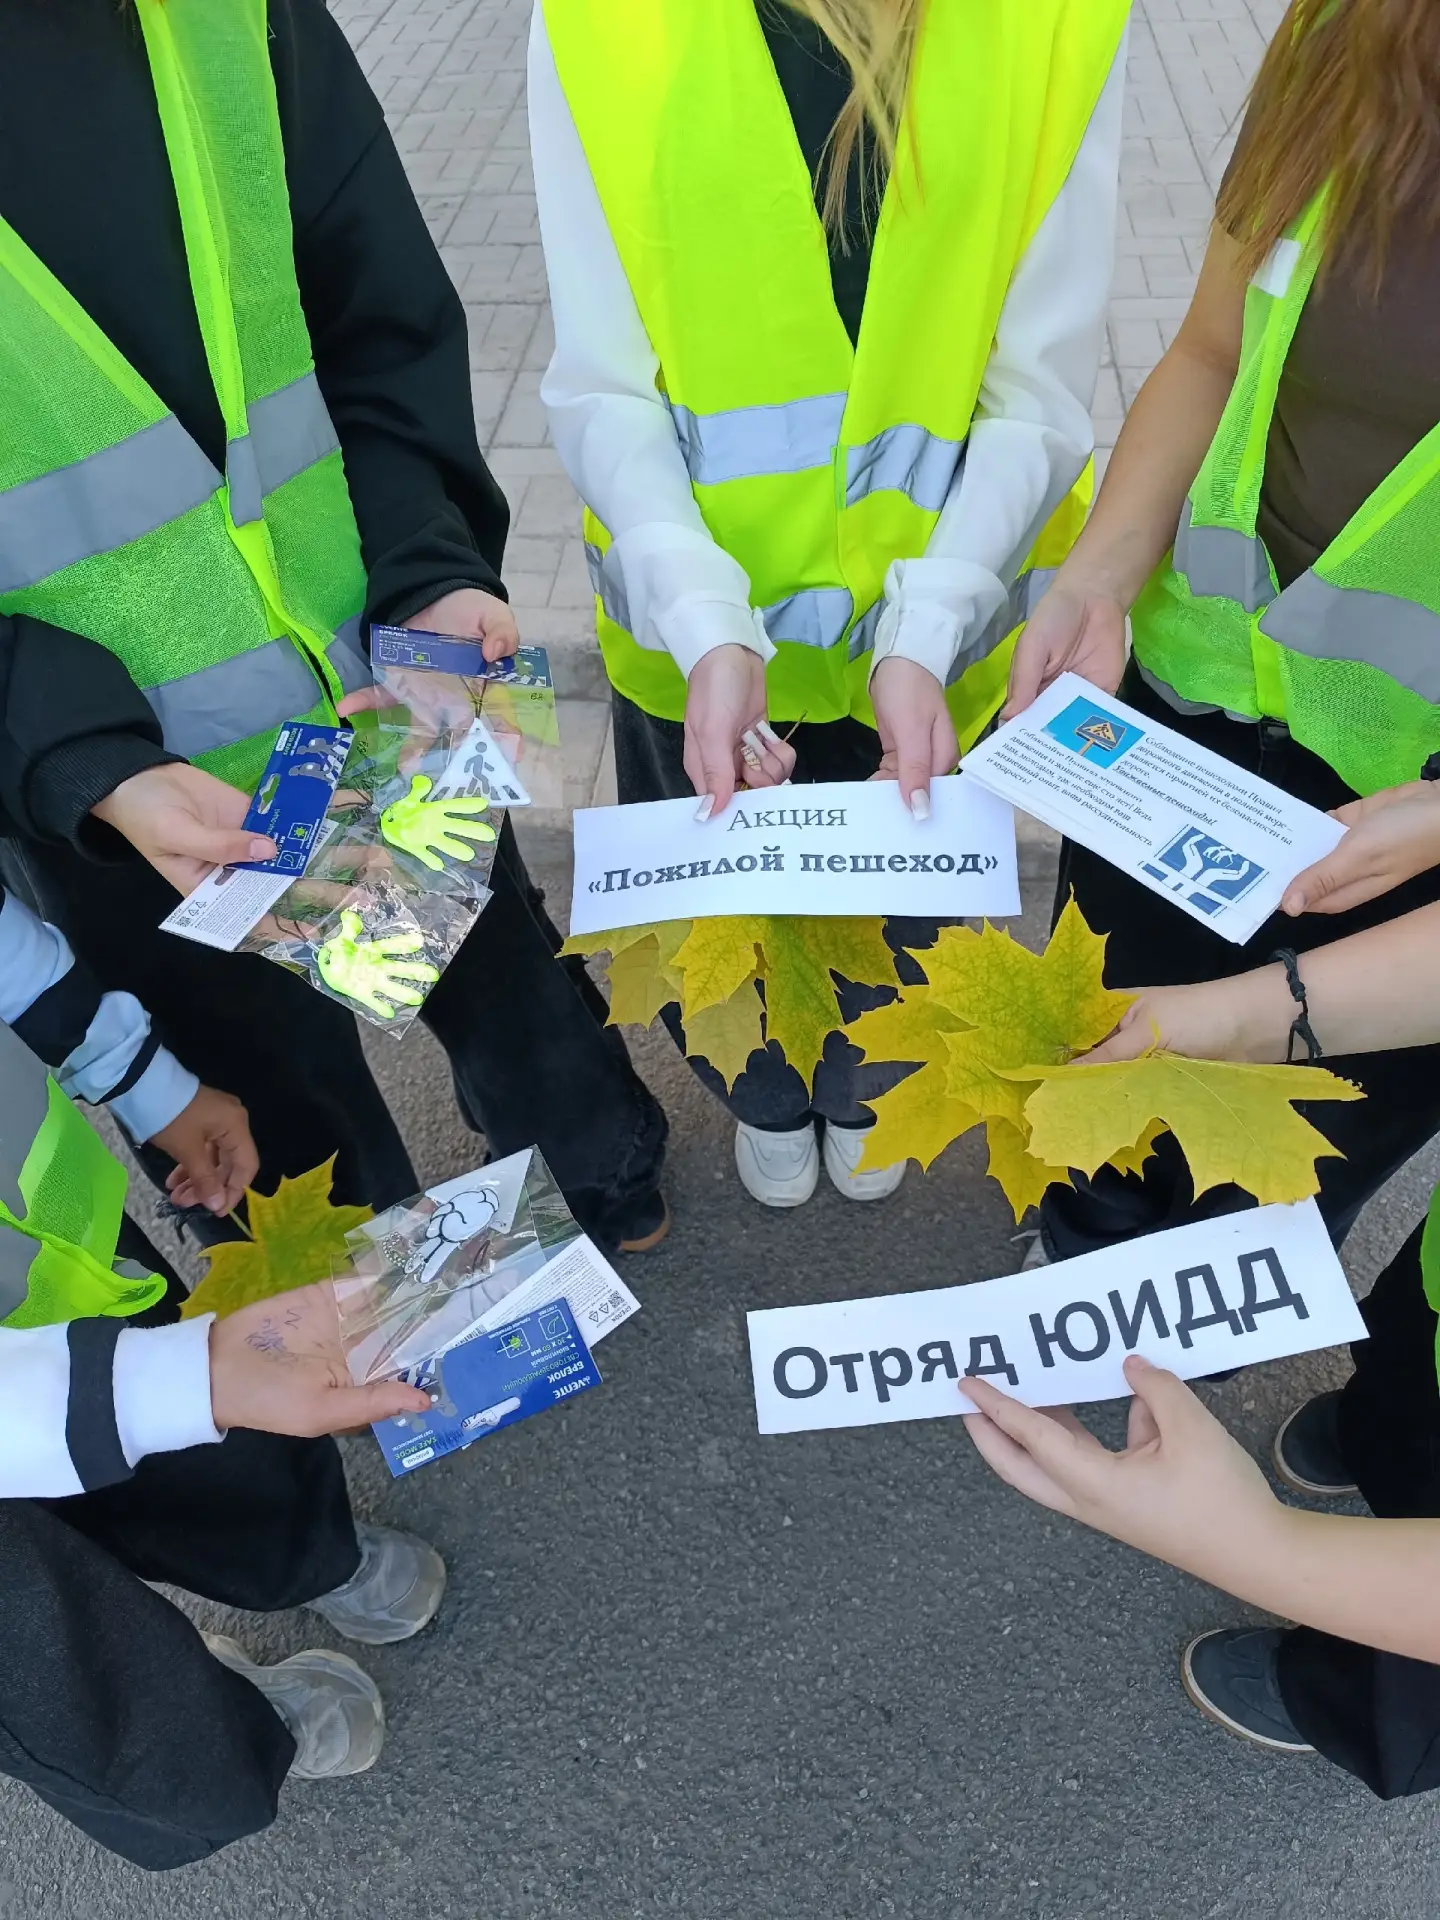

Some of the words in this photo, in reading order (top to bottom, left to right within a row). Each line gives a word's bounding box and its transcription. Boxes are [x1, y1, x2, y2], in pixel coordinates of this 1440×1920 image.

[993, 750, 1039, 778] жизненный
[1038, 776, 1060, 791] опыт,
[1060, 788, 1081, 802] ваша
[1080, 801, 1151, 845] рассудительность
[1009, 736, 1048, 760] движения
[1054, 762, 1084, 781] живите
[1100, 788, 1115, 798] сто
[1132, 806, 1151, 821] Ведь
[1057, 775, 1070, 785] так
[1070, 783, 1114, 810] необходим
[1113, 808, 1131, 821] ваш
[1112, 765, 1165, 799] Уважаемые
[1164, 795, 1217, 825] пешеходы!
[1128, 753, 1165, 773] является
[1165, 771, 1208, 797] гарантией
[1209, 795, 1220, 804] их
[1220, 801, 1279, 837] безопасности
[1280, 836, 1292, 845] на
[1135, 745, 1181, 770] дорожного
[1180, 769, 1223, 794] движения
[1230, 795, 1264, 816] полной
[1263, 814, 1286, 828] мере
[1145, 737, 1195, 766] Соблюдение
[1195, 764, 1247, 795] пешеходами
[1247, 792, 1282, 814] Правил
[726, 808, 848, 830] Акция
[588, 846, 785, 894] «Пожилой
[800, 852, 999, 875] пешеход»
[772, 1334, 1019, 1402] Отряд
[1029, 1246, 1310, 1368] ЮИДД
[546, 1360, 584, 1383] БРЕЛОК
[393, 1444, 418, 1460] MODE
[417, 1435, 437, 1449] SAFE
